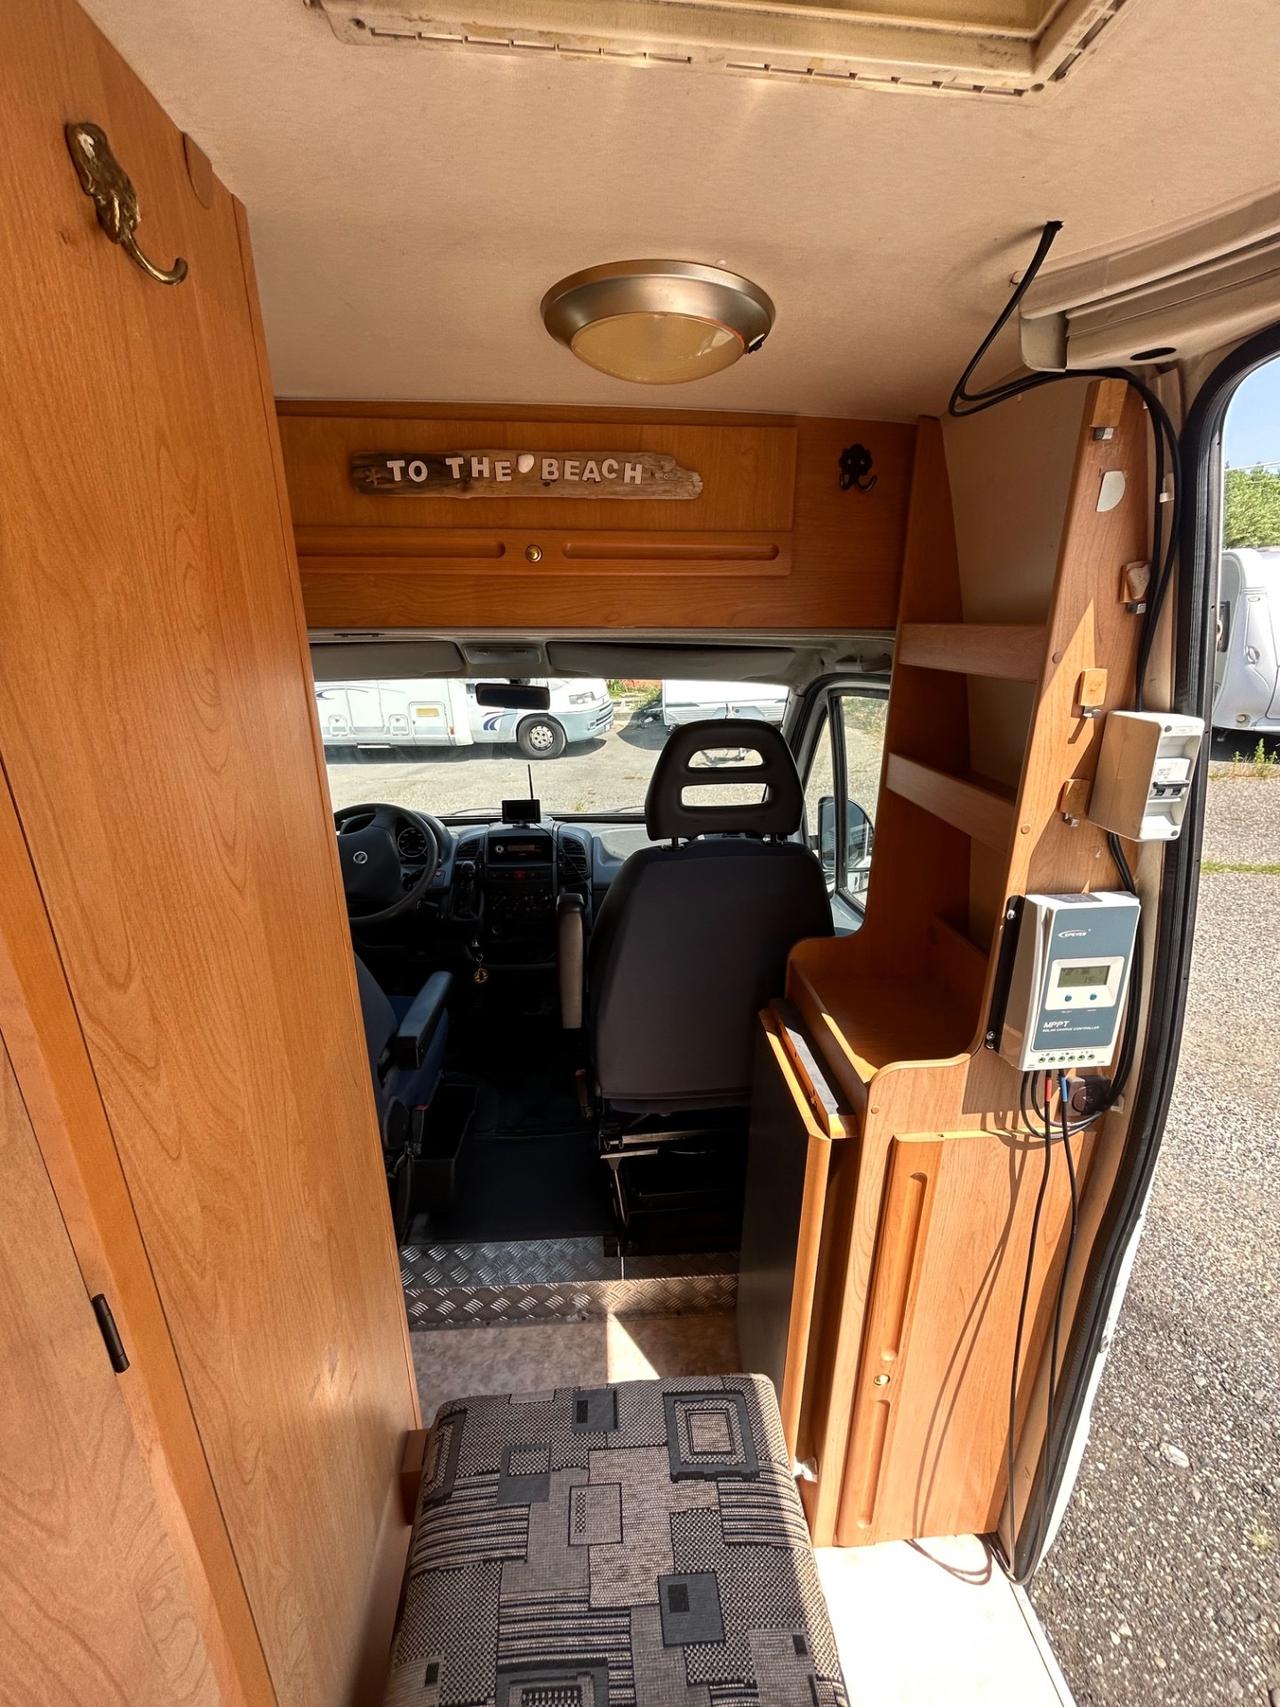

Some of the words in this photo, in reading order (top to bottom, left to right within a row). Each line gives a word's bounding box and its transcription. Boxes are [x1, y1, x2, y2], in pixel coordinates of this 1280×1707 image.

[386, 459, 428, 483] TO
[445, 456, 513, 482] THE
[541, 458, 644, 485] BEACH
[1043, 1020, 1070, 1029] MPPT
